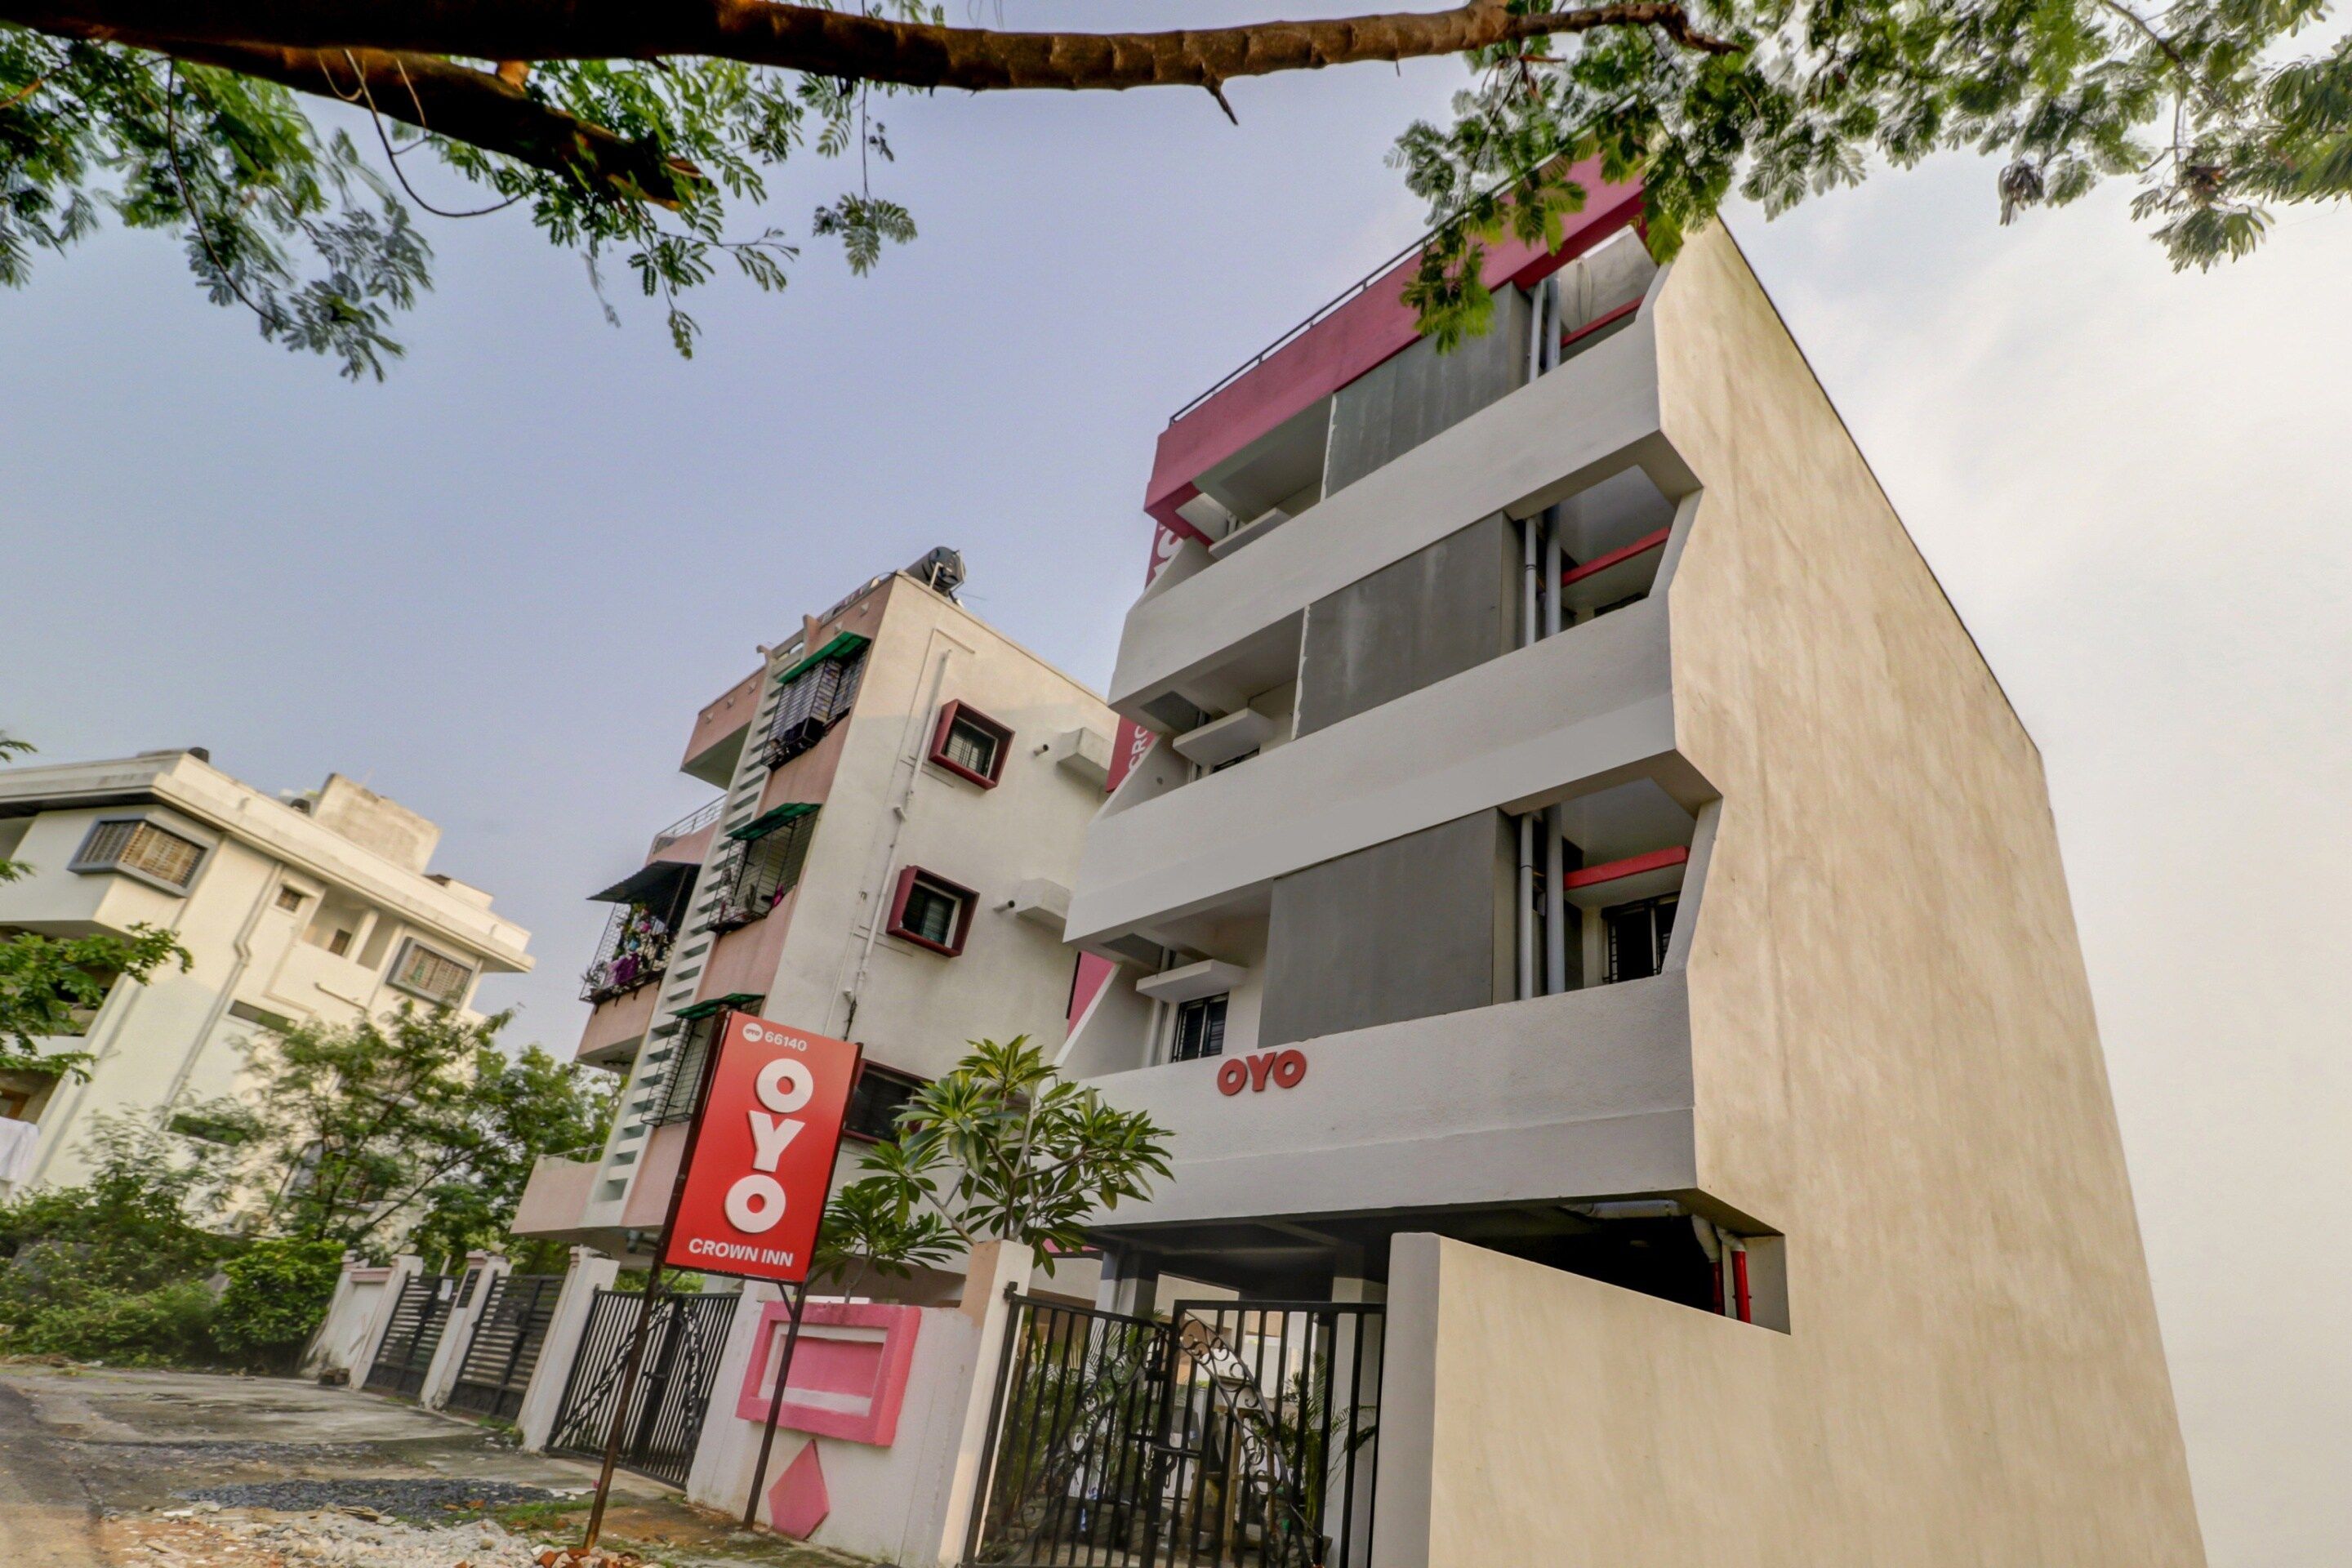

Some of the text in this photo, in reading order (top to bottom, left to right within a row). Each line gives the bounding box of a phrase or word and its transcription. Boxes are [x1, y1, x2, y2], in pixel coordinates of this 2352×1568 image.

[764, 1031, 807, 1051] 66140
[1217, 1049, 1307, 1096] OYO
[724, 1058, 813, 1234] OYO
[688, 1238, 794, 1267] CROWN INN
